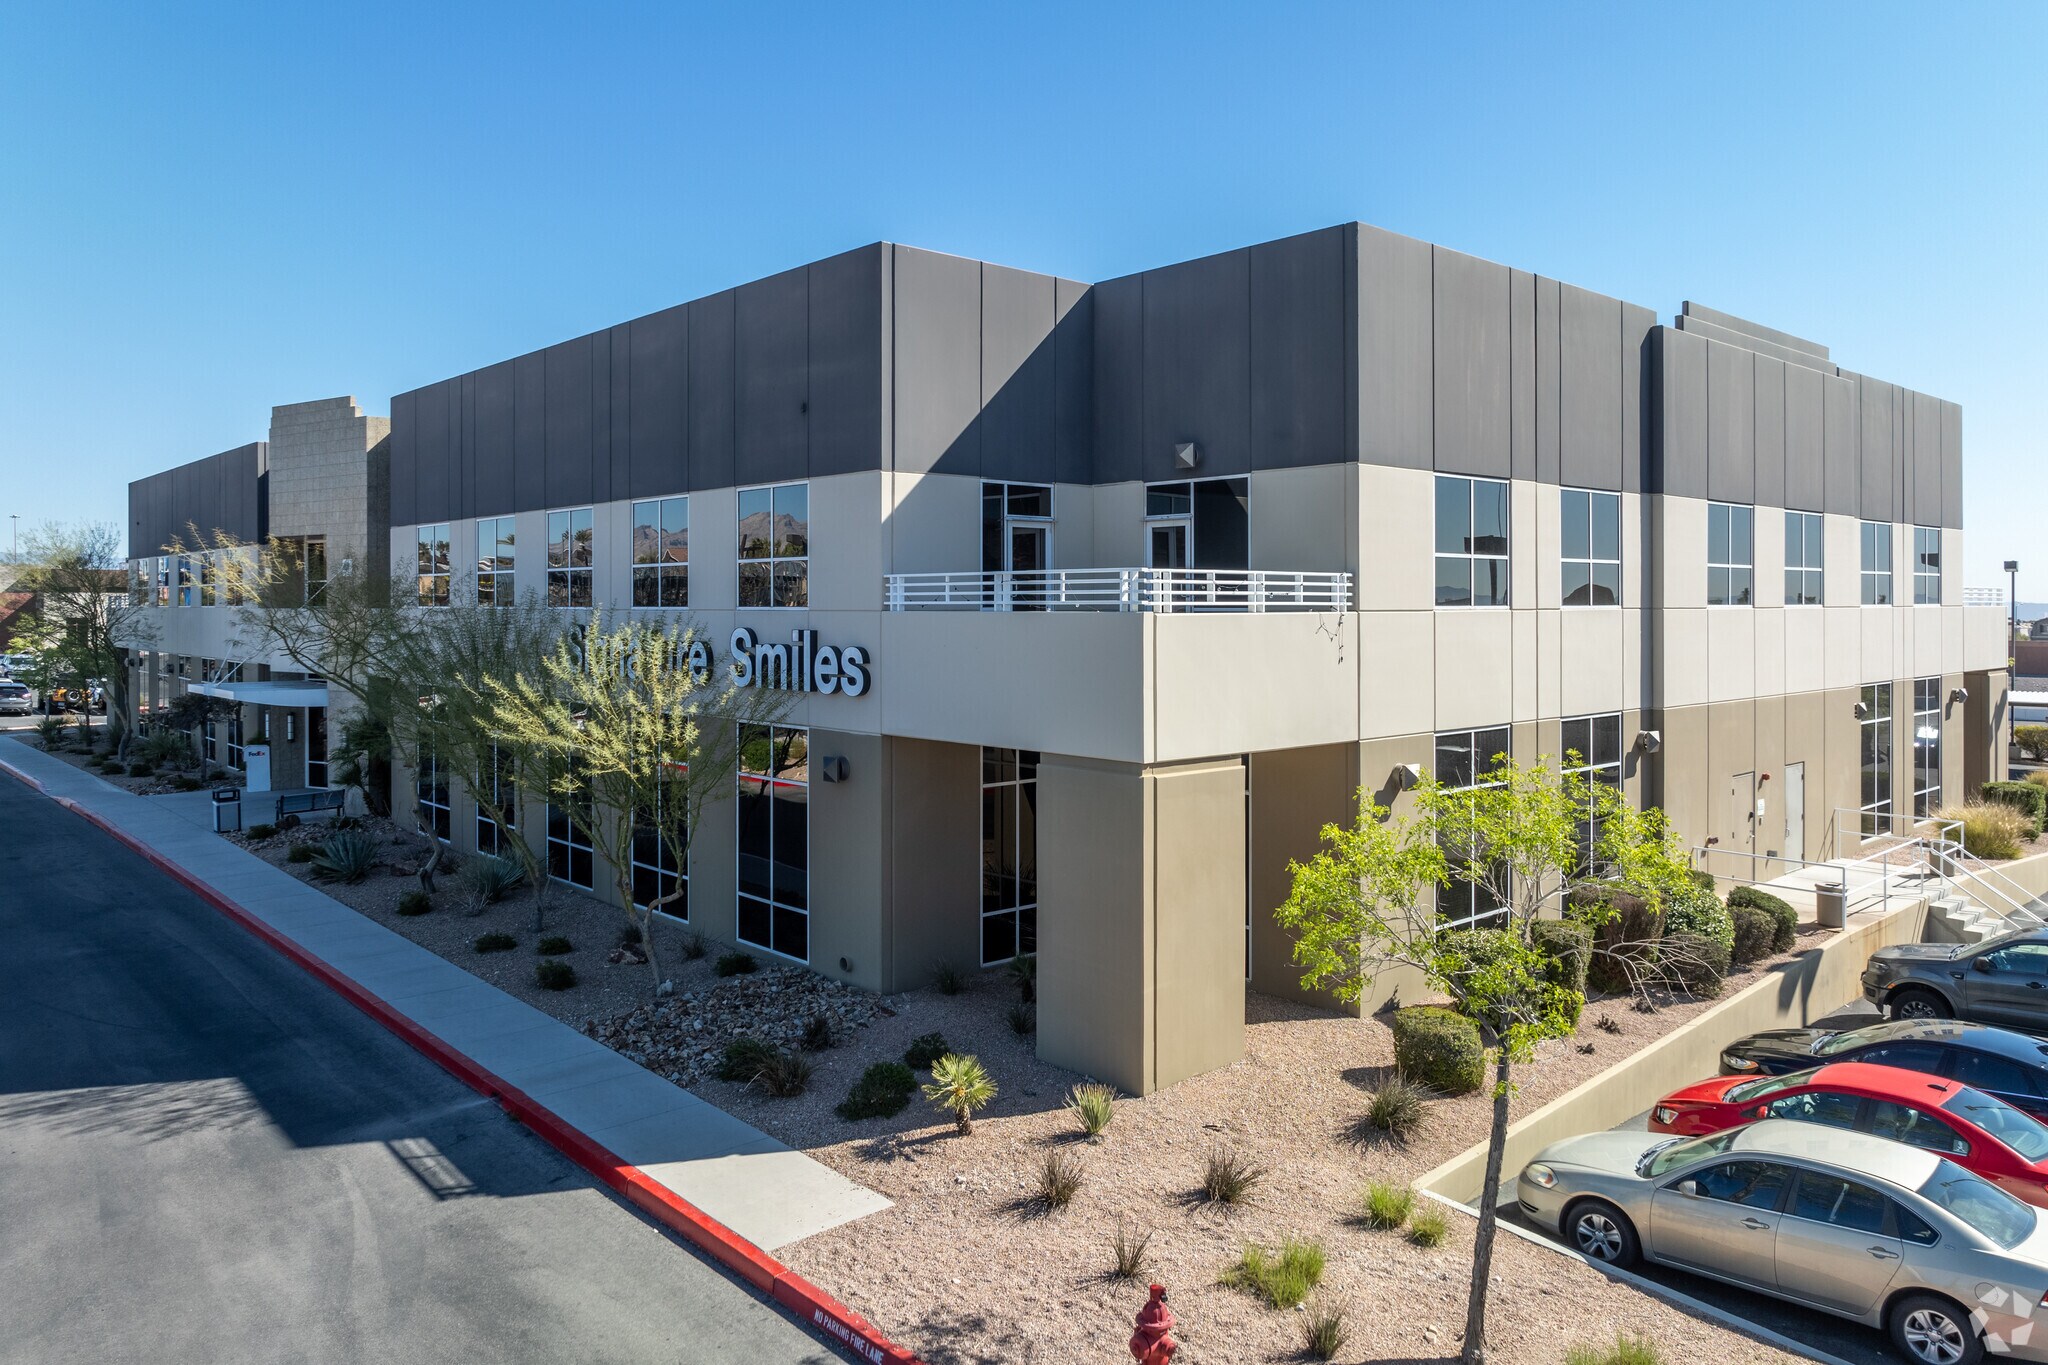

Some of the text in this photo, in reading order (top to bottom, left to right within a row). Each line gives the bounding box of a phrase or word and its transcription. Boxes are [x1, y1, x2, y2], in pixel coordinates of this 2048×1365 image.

[730, 627, 869, 697] Smiles
[814, 1309, 884, 1365] NO PARKING FIRE LANE
